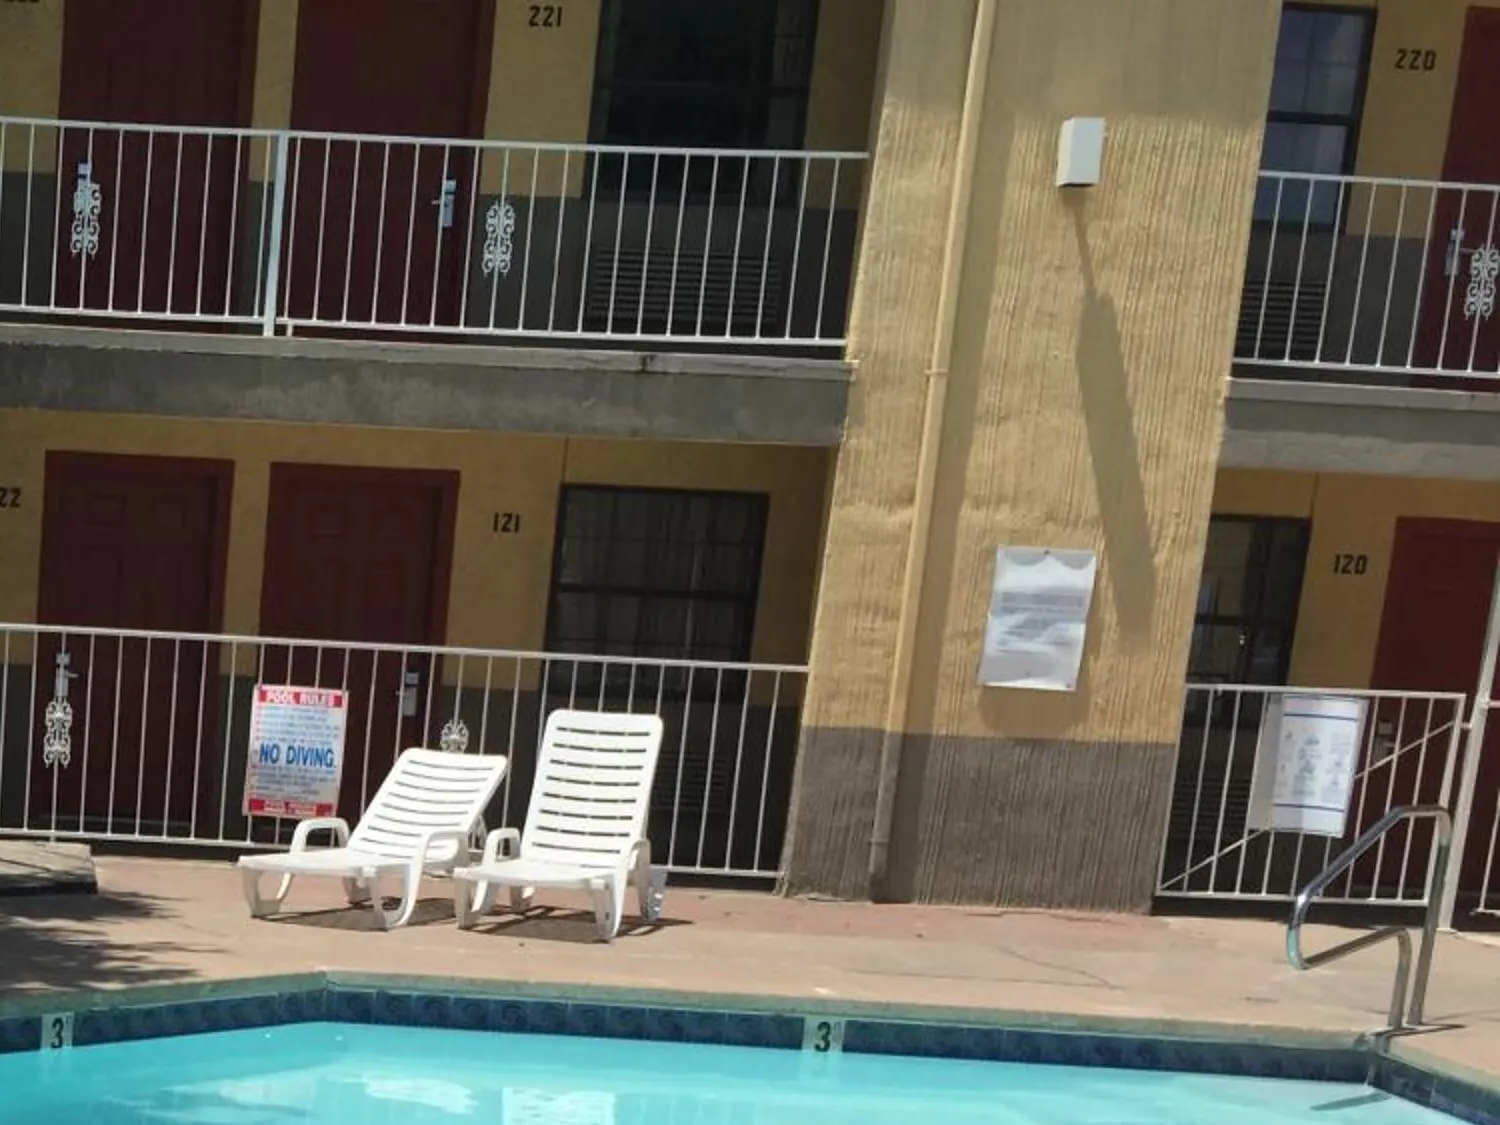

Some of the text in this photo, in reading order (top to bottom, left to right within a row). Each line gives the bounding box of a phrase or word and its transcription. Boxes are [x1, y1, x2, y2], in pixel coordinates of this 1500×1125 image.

[528, 5, 563, 28] 221
[1395, 48, 1437, 71] 220
[493, 511, 520, 534] 121
[1334, 553, 1368, 575] 120
[260, 743, 280, 765] NO
[51, 1016, 65, 1049] 3
[814, 1021, 831, 1052] 3
